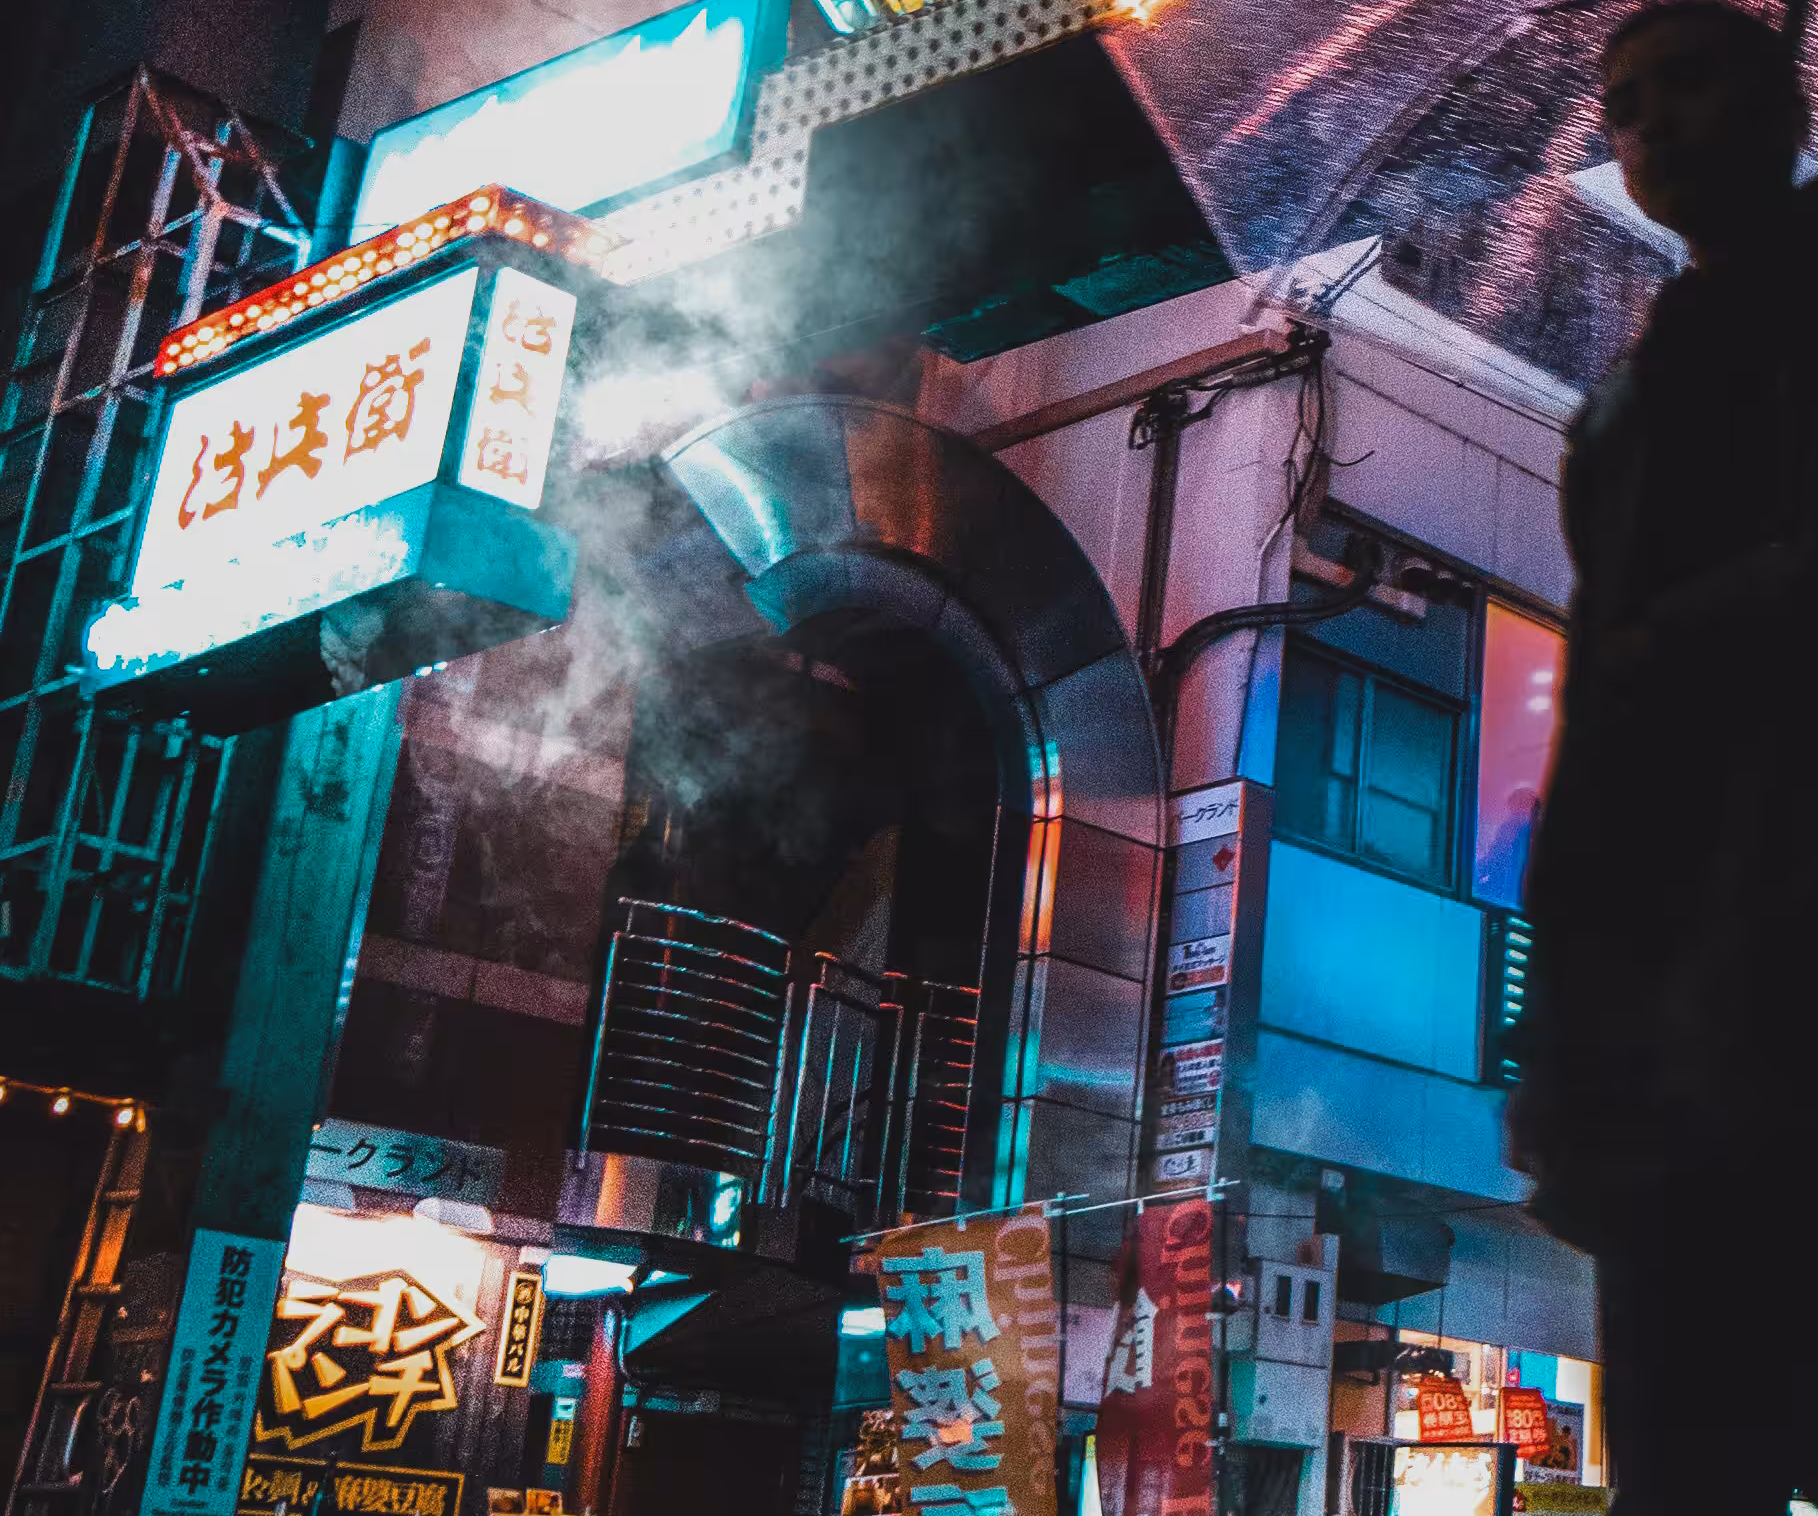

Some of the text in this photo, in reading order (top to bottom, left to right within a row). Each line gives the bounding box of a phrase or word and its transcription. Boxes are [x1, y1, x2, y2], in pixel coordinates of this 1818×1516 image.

[178, 1244, 257, 1496] 防犯カメラ作動中
[1158, 1198, 1214, 1468] Chinese
